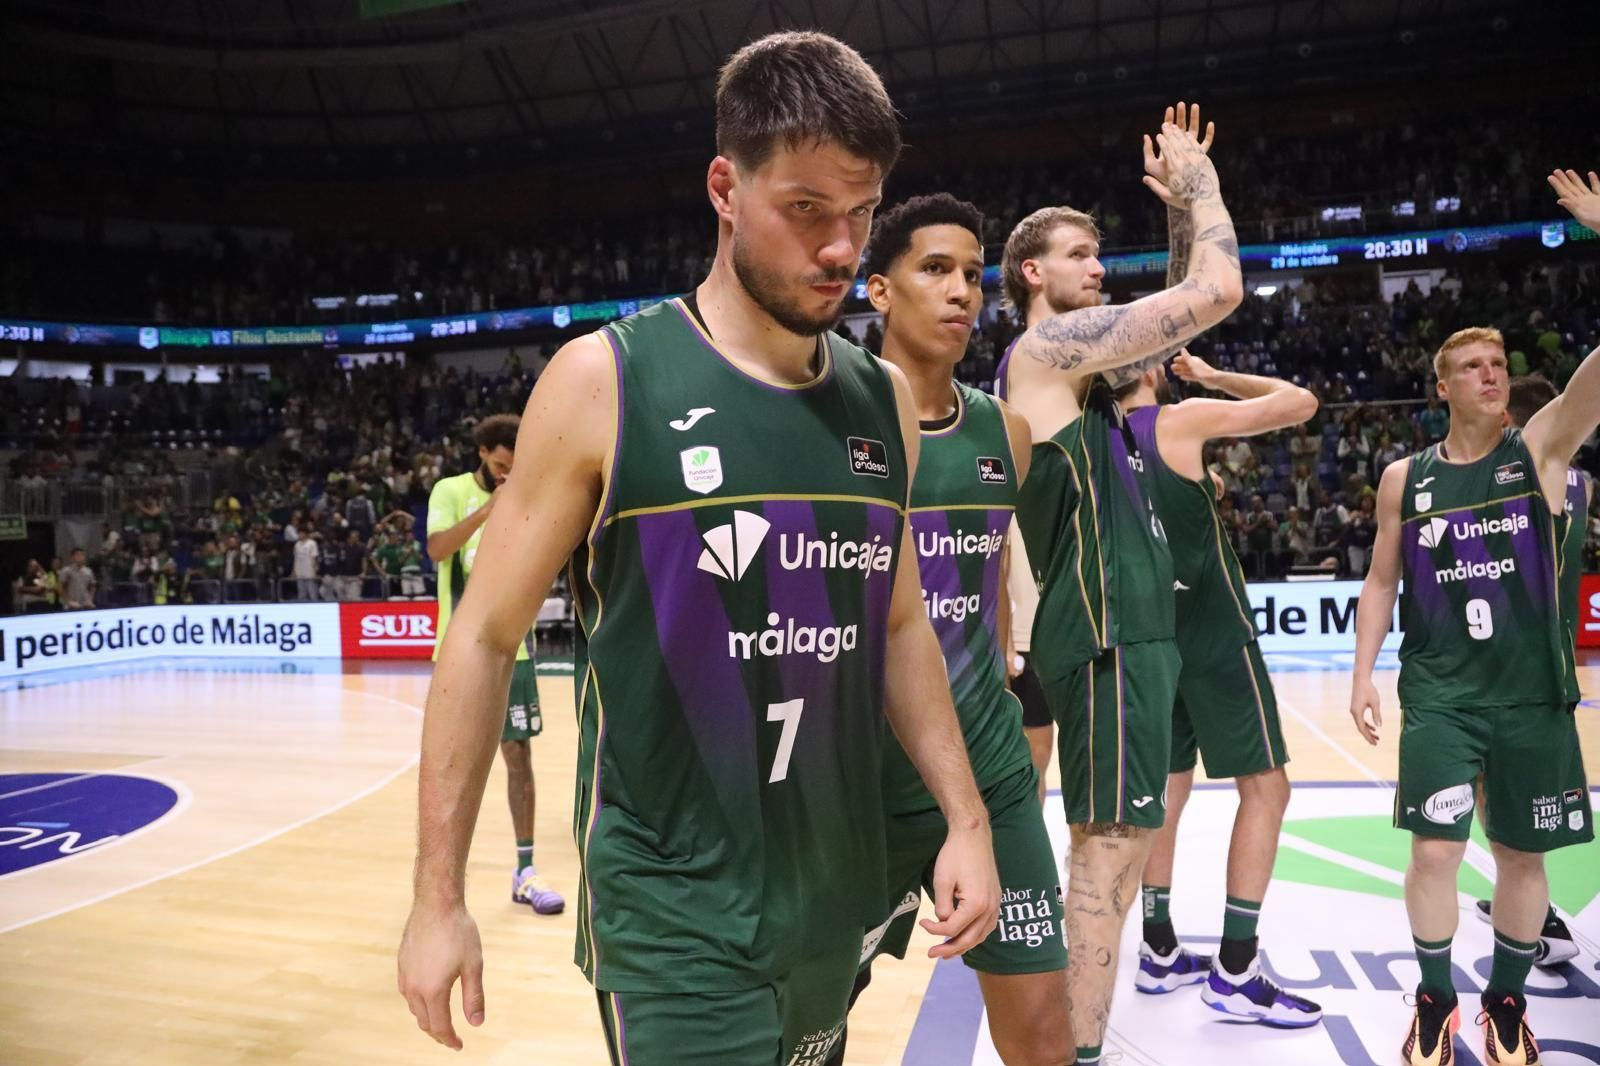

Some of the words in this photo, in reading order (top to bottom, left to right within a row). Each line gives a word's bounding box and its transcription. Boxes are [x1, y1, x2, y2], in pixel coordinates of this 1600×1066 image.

[1286, 256, 1299, 268] de
[1364, 240, 1413, 259] 20:30
[1416, 238, 1428, 255] H
[33, 327, 44, 341] H
[212, 330, 231, 345] VS
[853, 449, 870, 461] liga
[855, 460, 887, 473] endesa
[1453, 512, 1529, 541] Unicaja
[779, 531, 893, 580] Unicaja
[919, 528, 1002, 560] Unicaja
[360, 613, 436, 638] SUR
[1252, 596, 1307, 636] de
[1465, 598, 1494, 641] 9
[16, 618, 166, 668] periódico
[172, 614, 204, 645] de
[212, 613, 313, 653] Málaga
[766, 697, 805, 784] 7
[1000, 887, 1033, 903] abor
[1004, 889, 1053, 922] má
[998, 918, 1056, 948] laga
